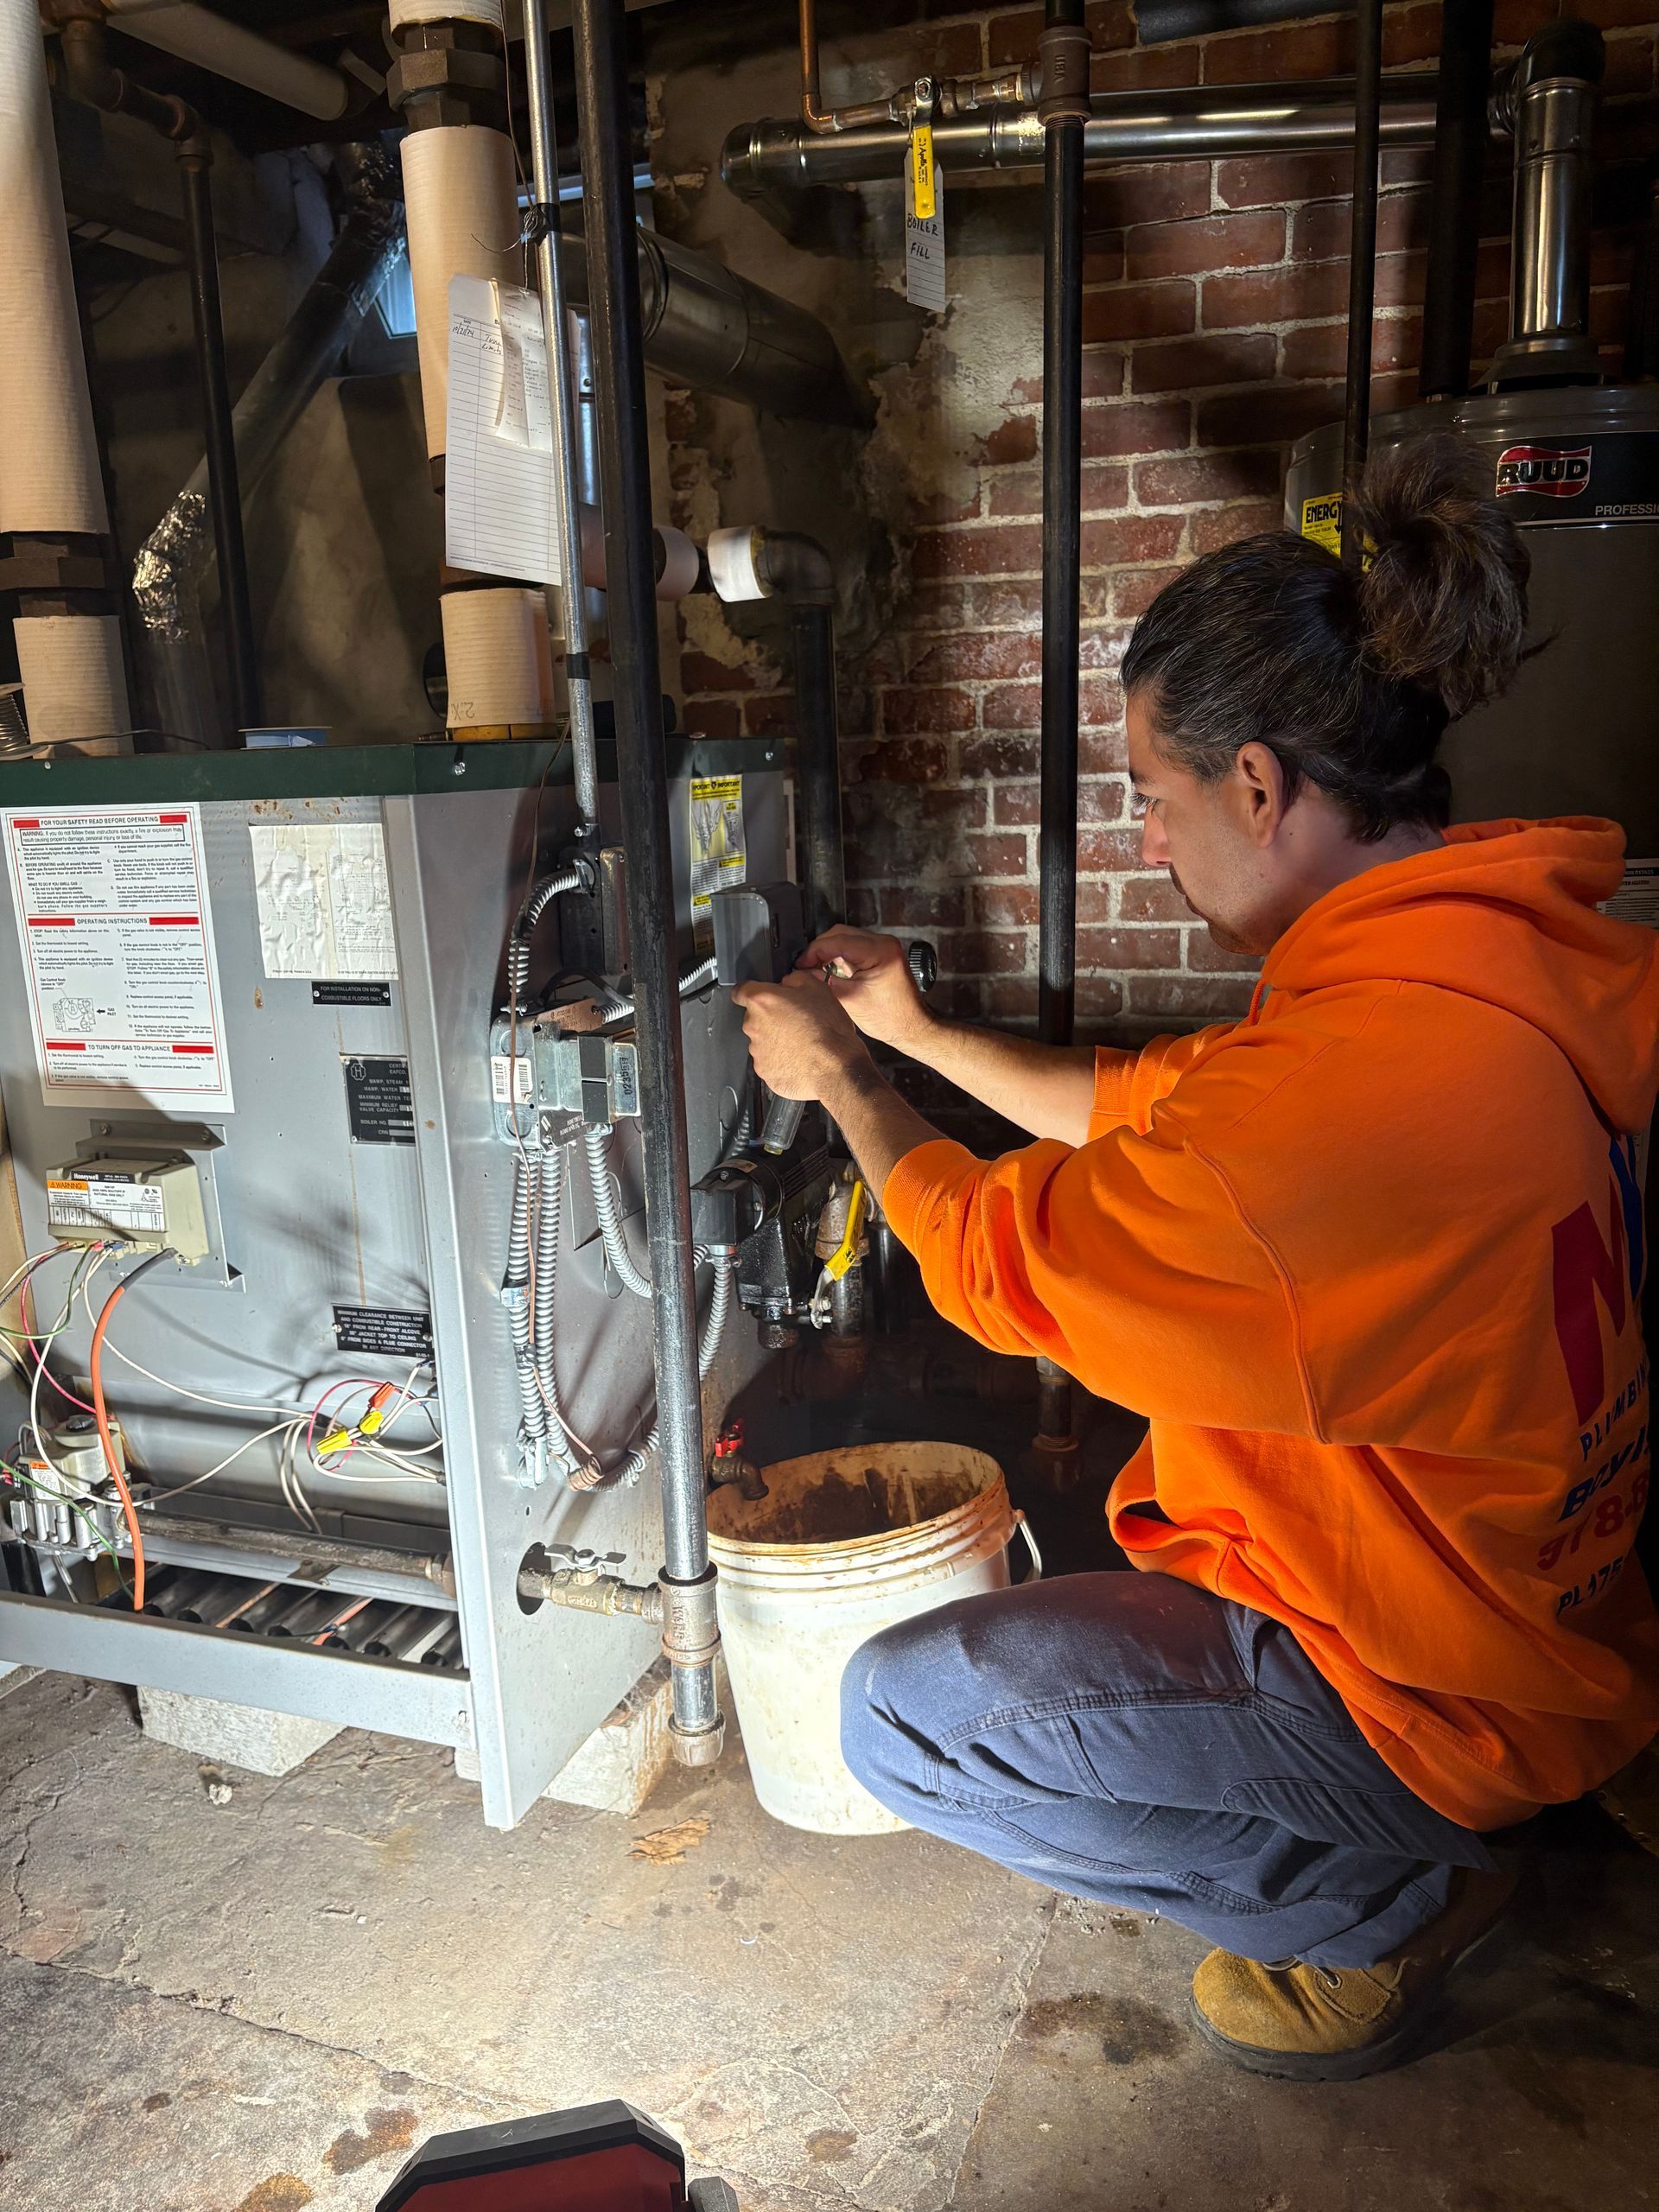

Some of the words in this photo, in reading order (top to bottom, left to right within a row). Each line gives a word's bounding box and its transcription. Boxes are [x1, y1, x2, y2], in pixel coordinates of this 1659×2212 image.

[907, 213, 938, 236] BOILER
[910, 242, 930, 259] FILL
[1499, 459, 1589, 485] RUUD
